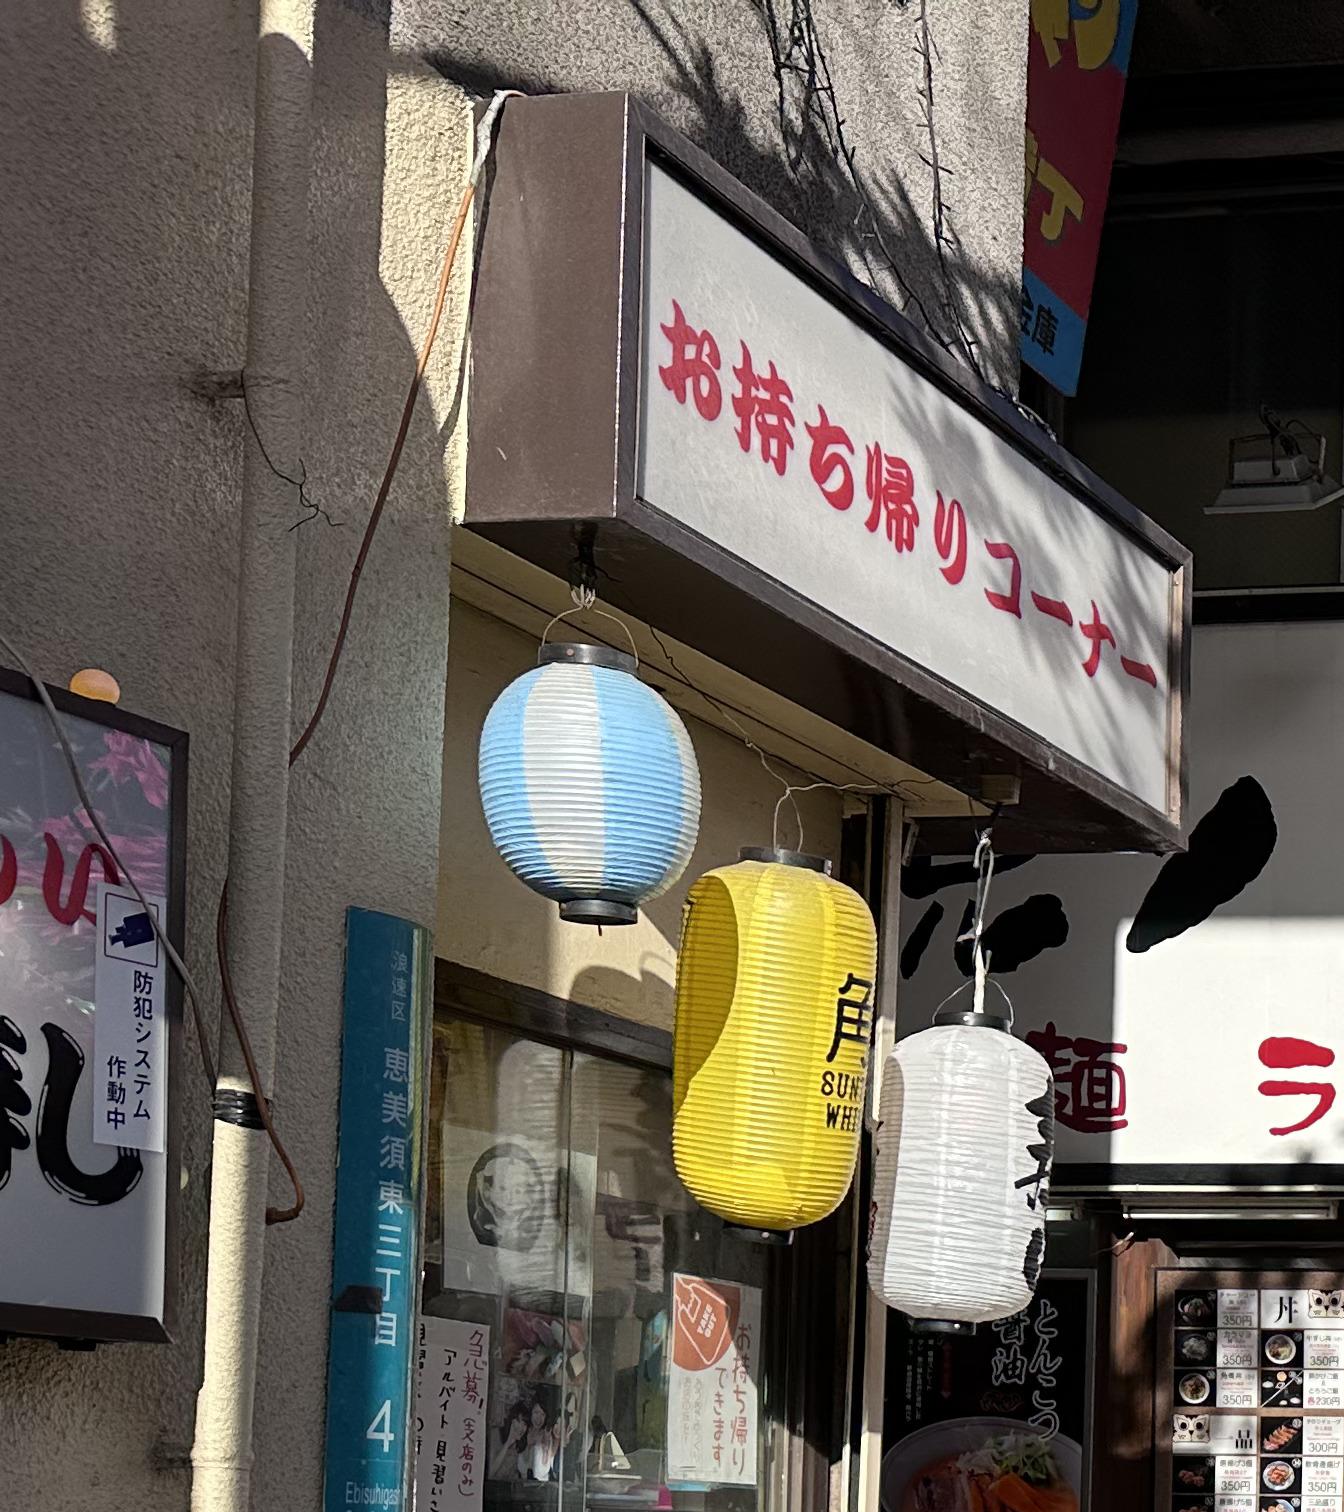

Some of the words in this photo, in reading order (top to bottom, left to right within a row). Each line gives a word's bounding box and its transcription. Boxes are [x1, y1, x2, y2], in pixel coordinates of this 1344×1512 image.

[658, 298, 1158, 689] お持ち帰りコーナー
[133, 970, 153, 1121] 防犯システム
[107, 1055, 127, 1130] 作動中
[374, 1047, 409, 1347] 恵美須東三丁目
[698, 1304, 713, 1335] TAKE
[1028, 1299, 1063, 1441] とんこつ
[1223, 1355, 1252, 1365] 350円
[1310, 1356, 1339, 1366] 350円
[731, 1323, 752, 1476] お持ち帰り
[1223, 1395, 1252, 1405] 350円
[366, 1400, 395, 1452] 4
[1309, 1443, 1338, 1452] 300円
[1221, 1481, 1250, 1491] 350円
[1308, 1482, 1337, 1492] 350円
